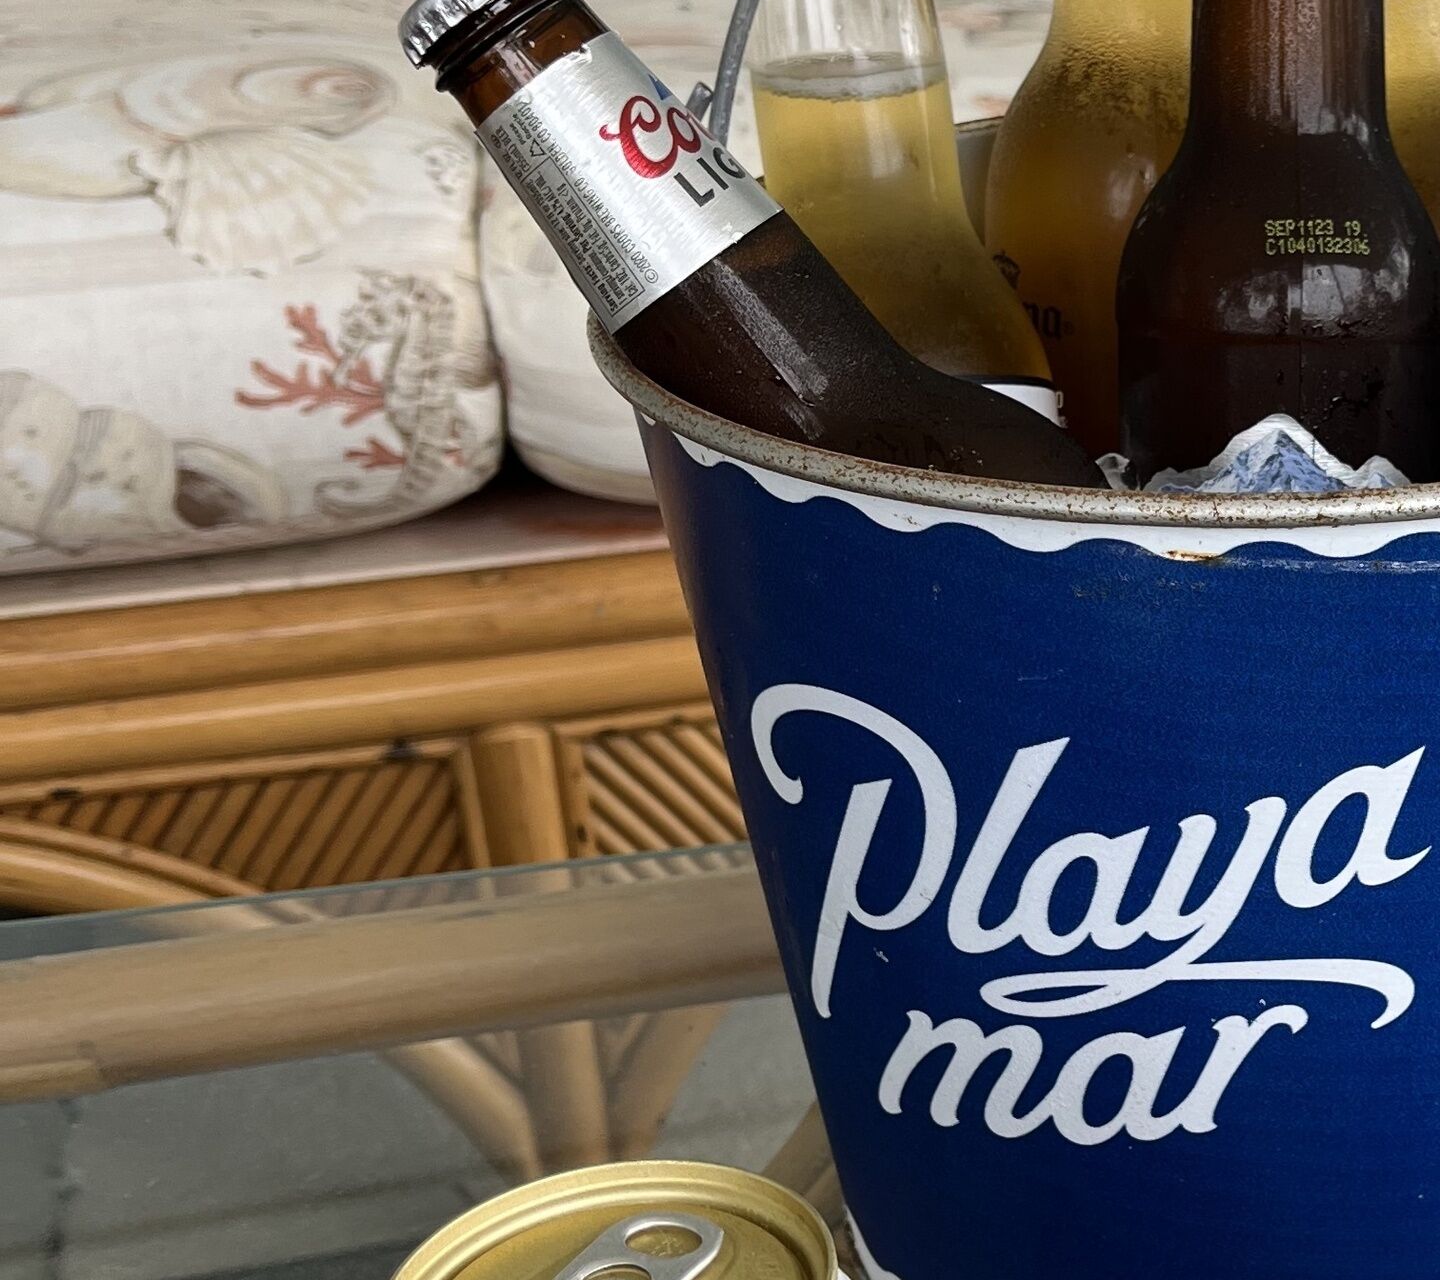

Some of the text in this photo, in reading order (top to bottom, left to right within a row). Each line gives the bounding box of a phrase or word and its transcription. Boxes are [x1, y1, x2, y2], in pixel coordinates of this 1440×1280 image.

[674, 146, 746, 207] LIG
[750, 682, 1433, 1029] Playa
[877, 1003, 1309, 1147] mar
